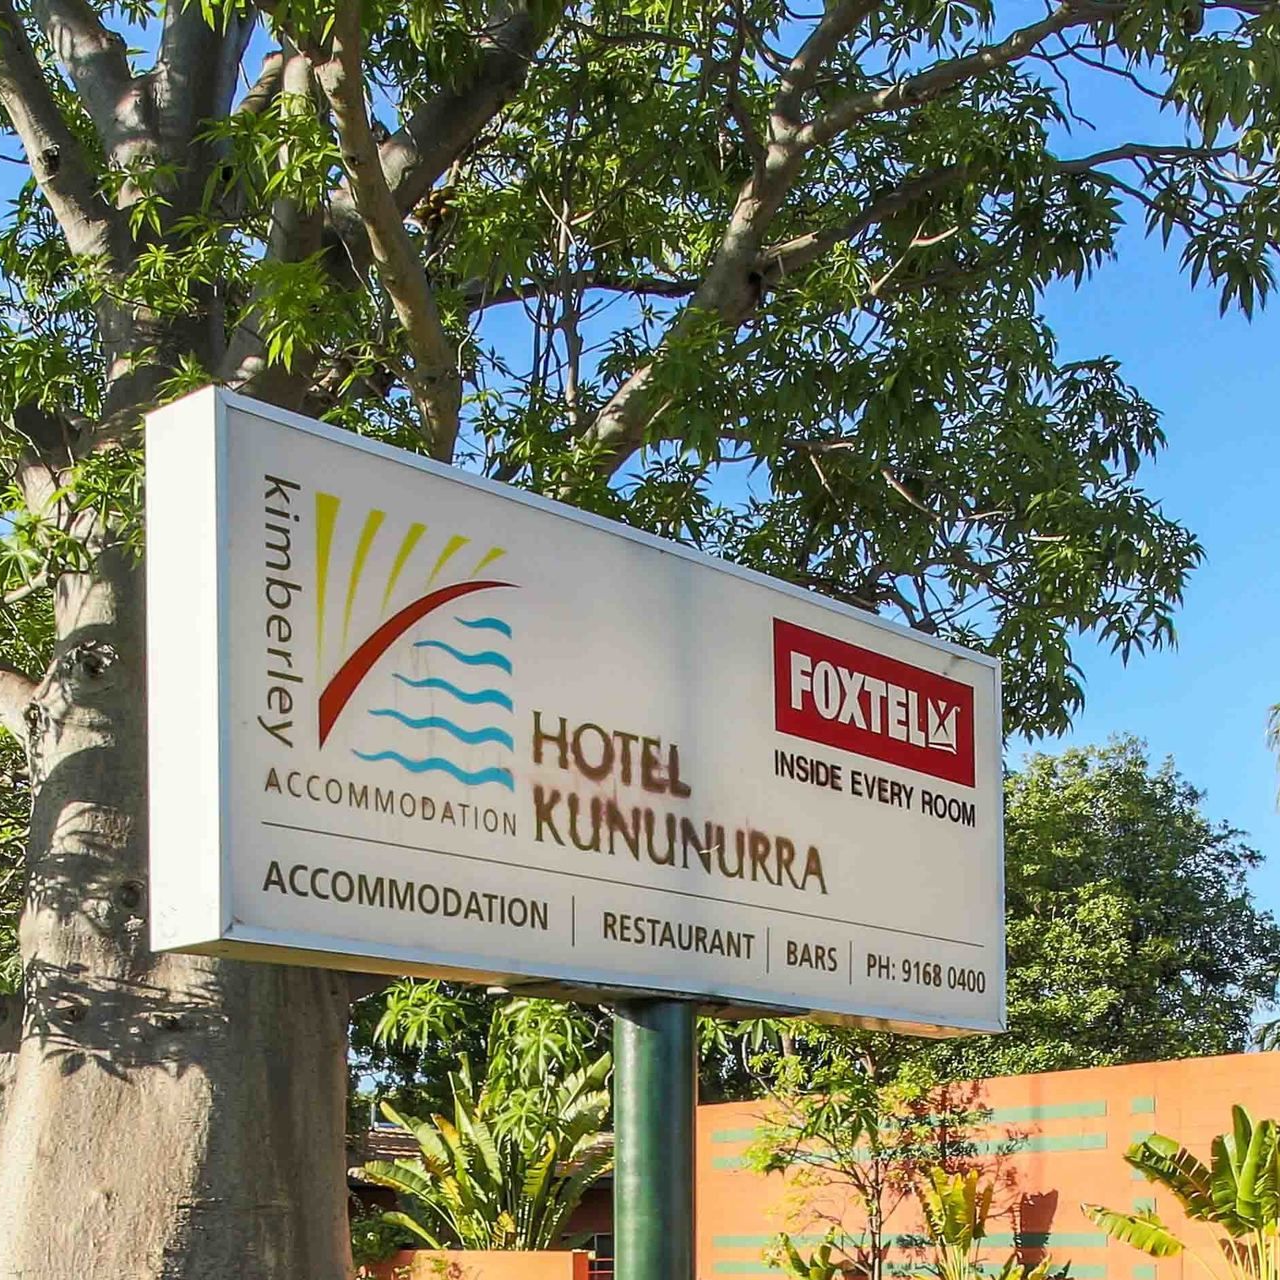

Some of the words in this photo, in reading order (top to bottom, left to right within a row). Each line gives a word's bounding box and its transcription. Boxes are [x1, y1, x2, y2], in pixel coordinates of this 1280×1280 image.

[257, 474, 304, 749] kimberley
[790, 650, 926, 748] FOXTEL
[264, 767, 517, 837] ACCOMMODATION
[533, 709, 692, 798] HOTEL
[774, 749, 843, 792] INSIDE
[851, 770, 914, 810] EVERY
[921, 790, 976, 828] ROOM
[533, 783, 829, 895] KUNUNURRA
[262, 860, 549, 931] ACCOMMODATION
[602, 911, 756, 960] RESTAURANT
[785, 940, 839, 972] BARS
[866, 953, 896, 981] PH:
[901, 961, 943, 988] 9168
[947, 966, 986, 994] 0400
